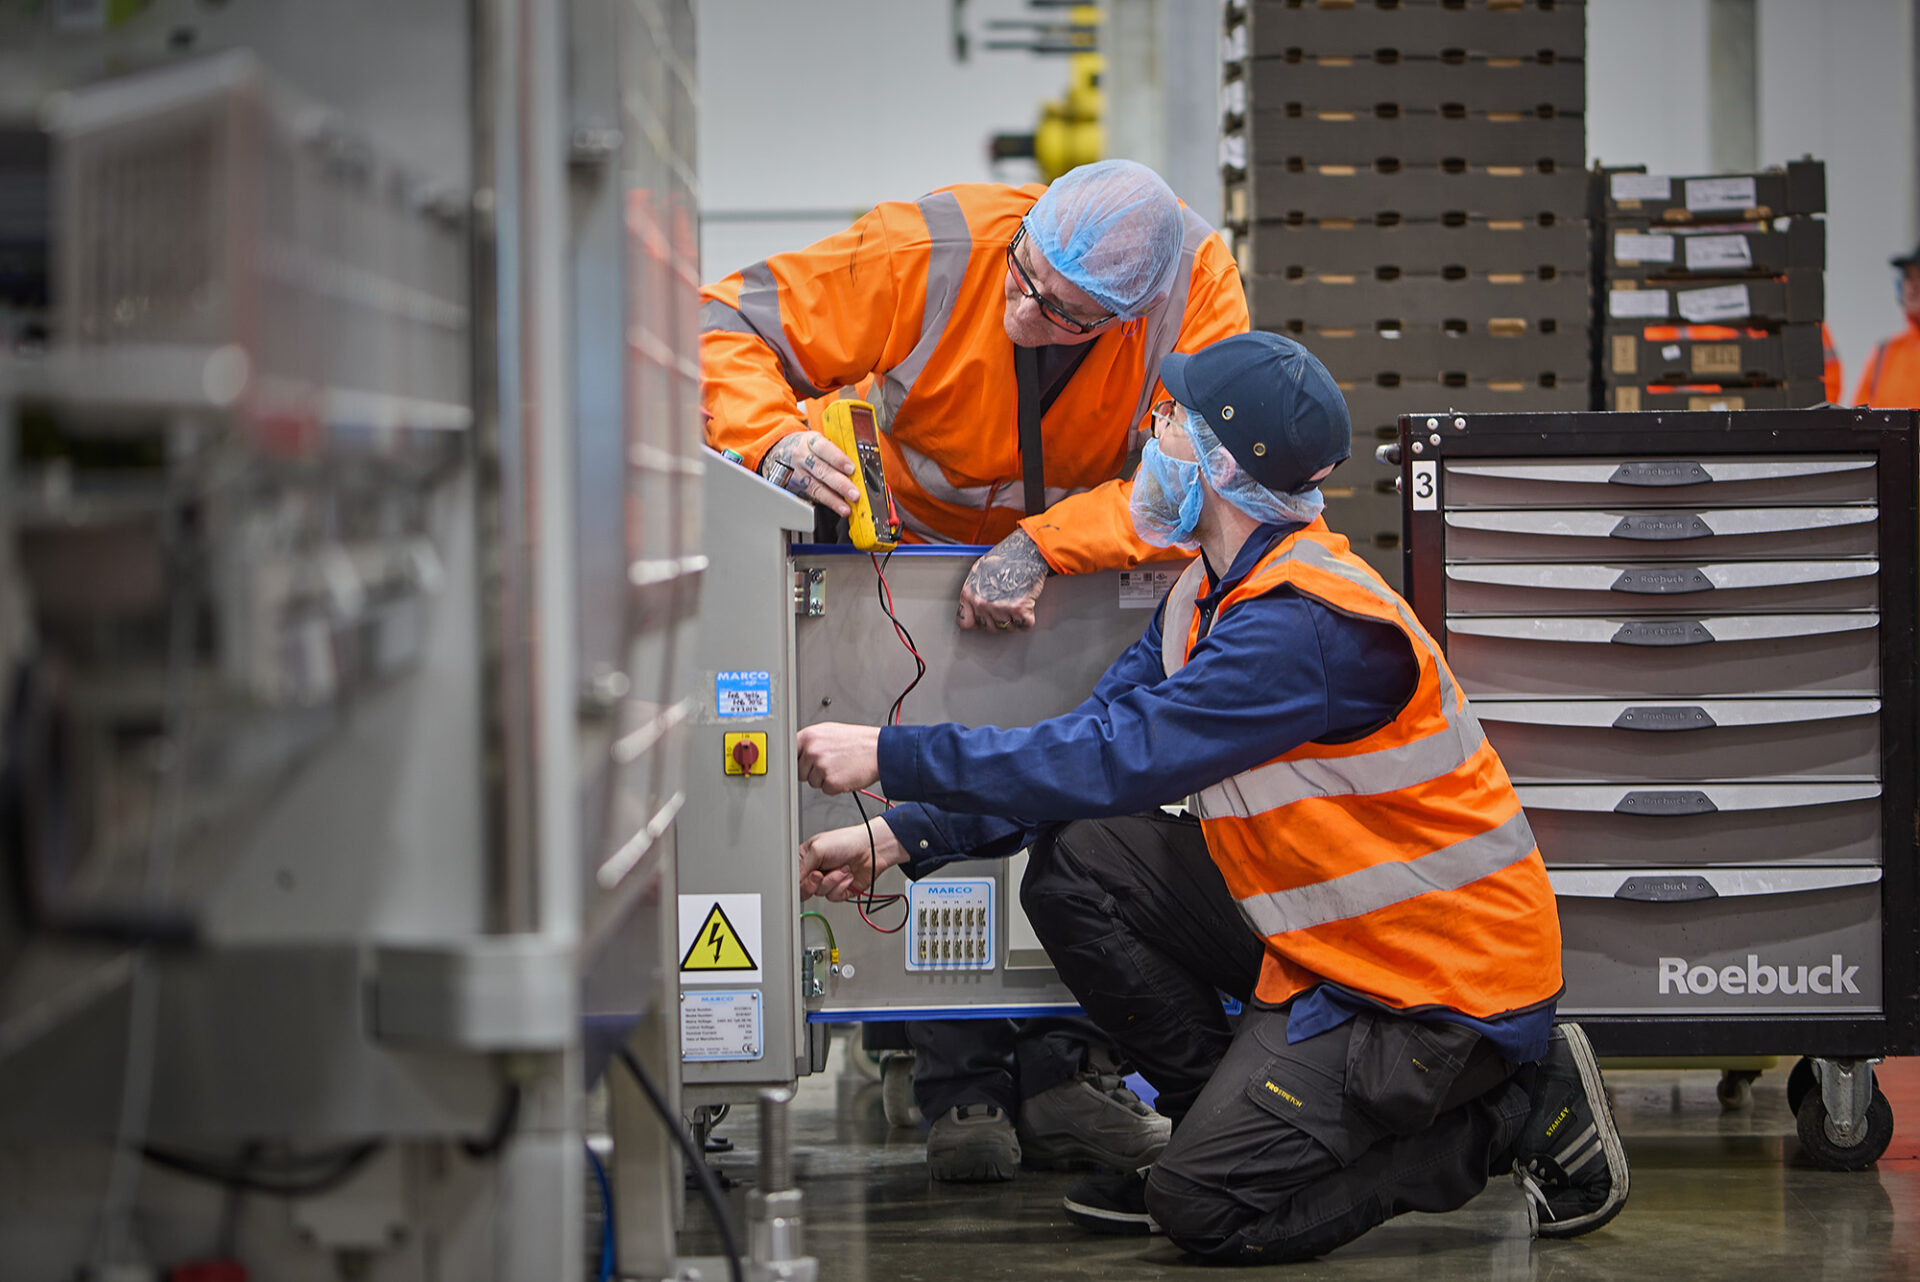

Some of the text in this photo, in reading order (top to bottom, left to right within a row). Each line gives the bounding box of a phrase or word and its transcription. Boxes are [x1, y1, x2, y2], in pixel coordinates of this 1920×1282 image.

[1416, 472, 1433, 498] 3
[1639, 521, 1683, 529] Roebuck
[1641, 575, 1684, 583] Roebuck
[718, 671, 769, 680] MARCO
[1658, 954, 1861, 994] Roebuck
[1546, 1106, 1569, 1137] STANLEY
